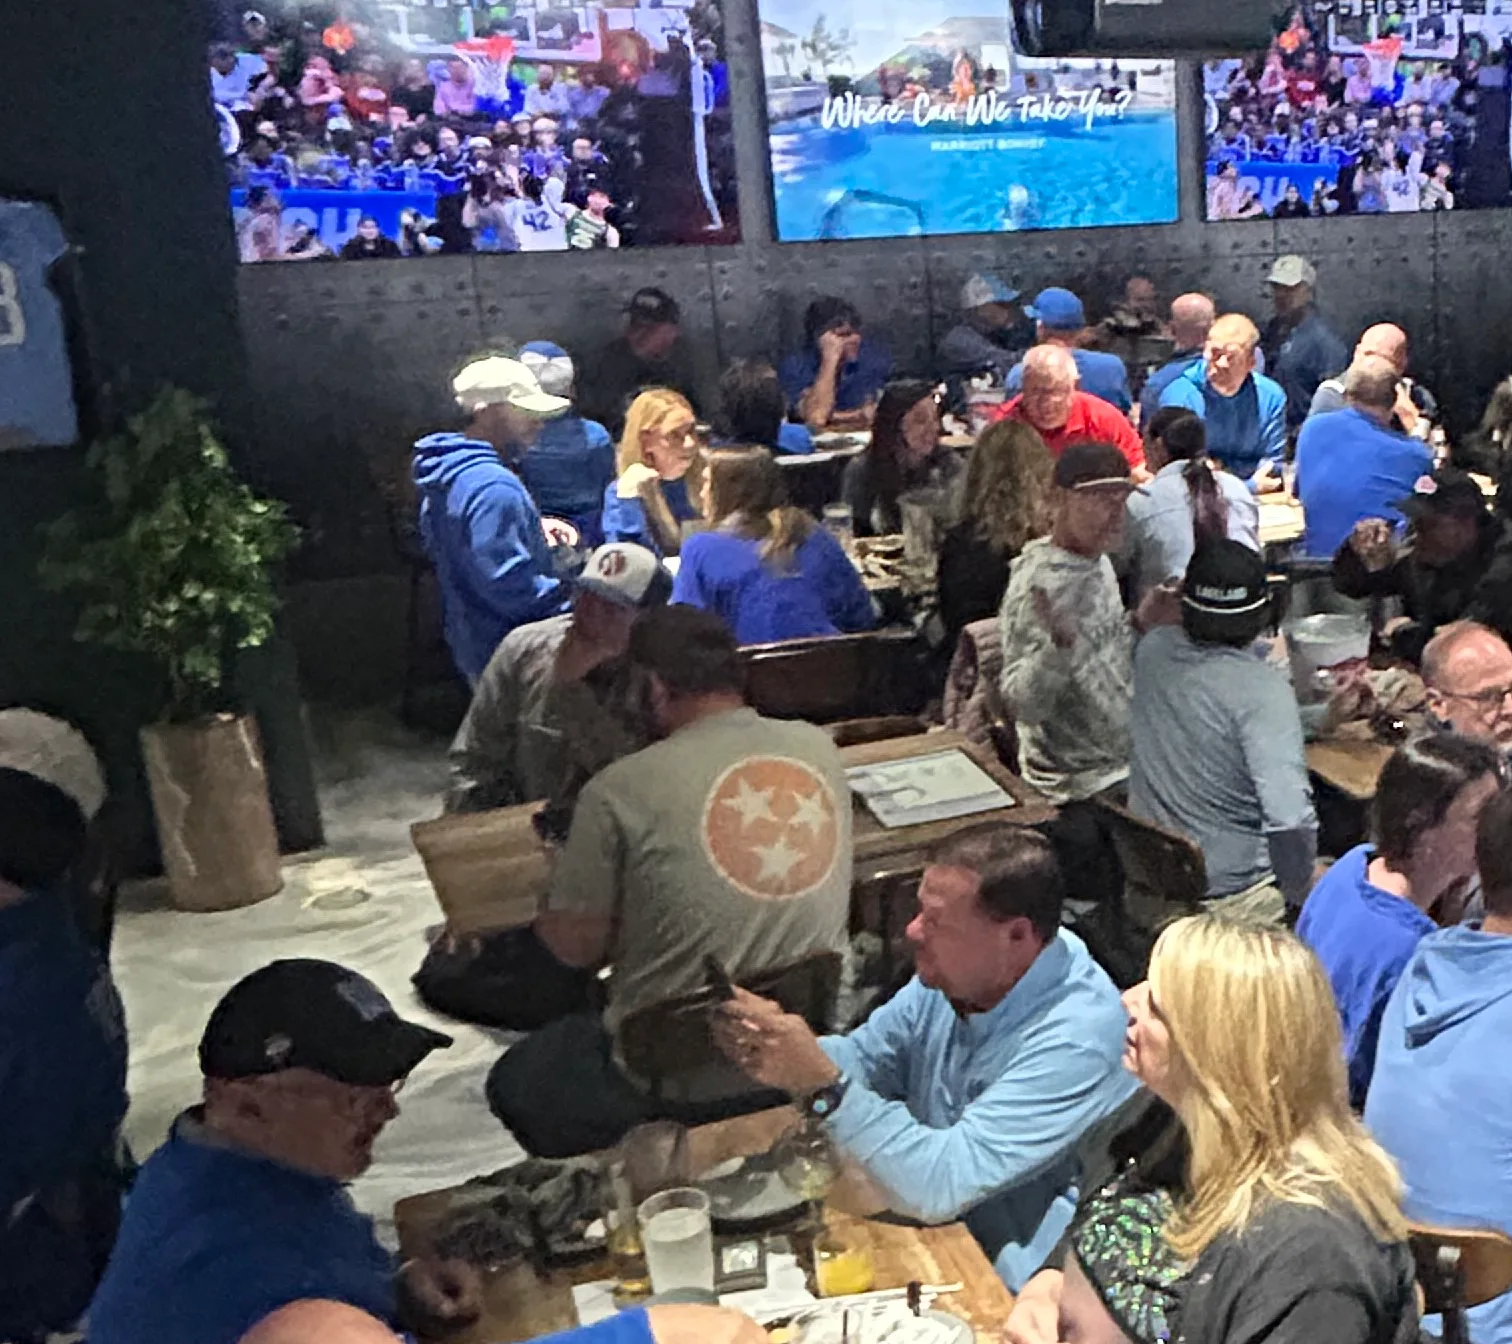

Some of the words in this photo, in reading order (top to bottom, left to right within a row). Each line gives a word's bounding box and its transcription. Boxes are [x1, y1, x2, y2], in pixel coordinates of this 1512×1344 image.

[820, 90, 906, 129] Where
[912, 92, 957, 127] Can
[966, 91, 1009, 126] We
[1014, 90, 1076, 122] Take
[1078, 89, 1133, 131] You?
[522, 210, 554, 232] 42
